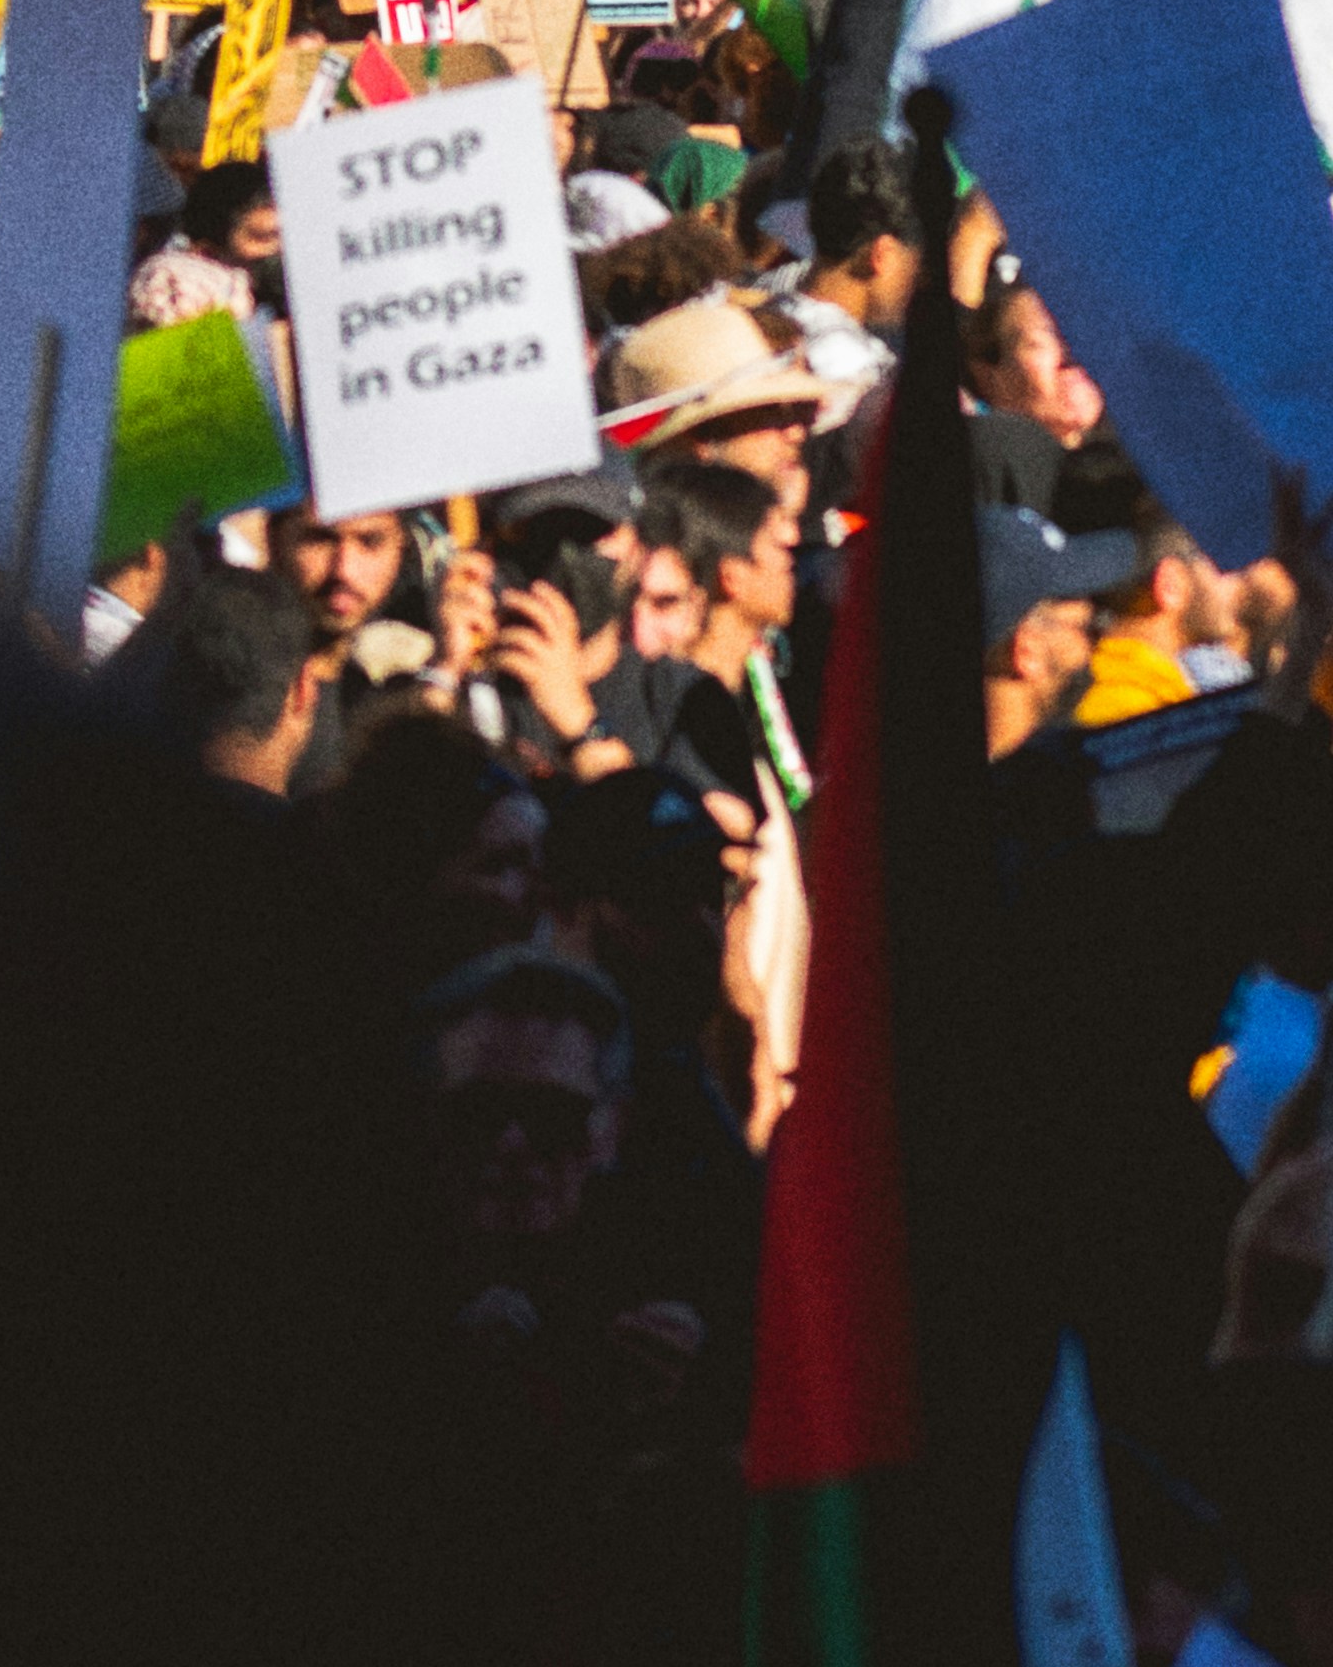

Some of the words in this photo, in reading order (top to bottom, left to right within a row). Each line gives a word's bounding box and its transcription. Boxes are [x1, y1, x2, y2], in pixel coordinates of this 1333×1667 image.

[339, 126, 483, 197] STOP
[339, 201, 506, 264] killing
[339, 264, 527, 350] people
[339, 363, 392, 406] in
[405, 335, 546, 391] Gaza
